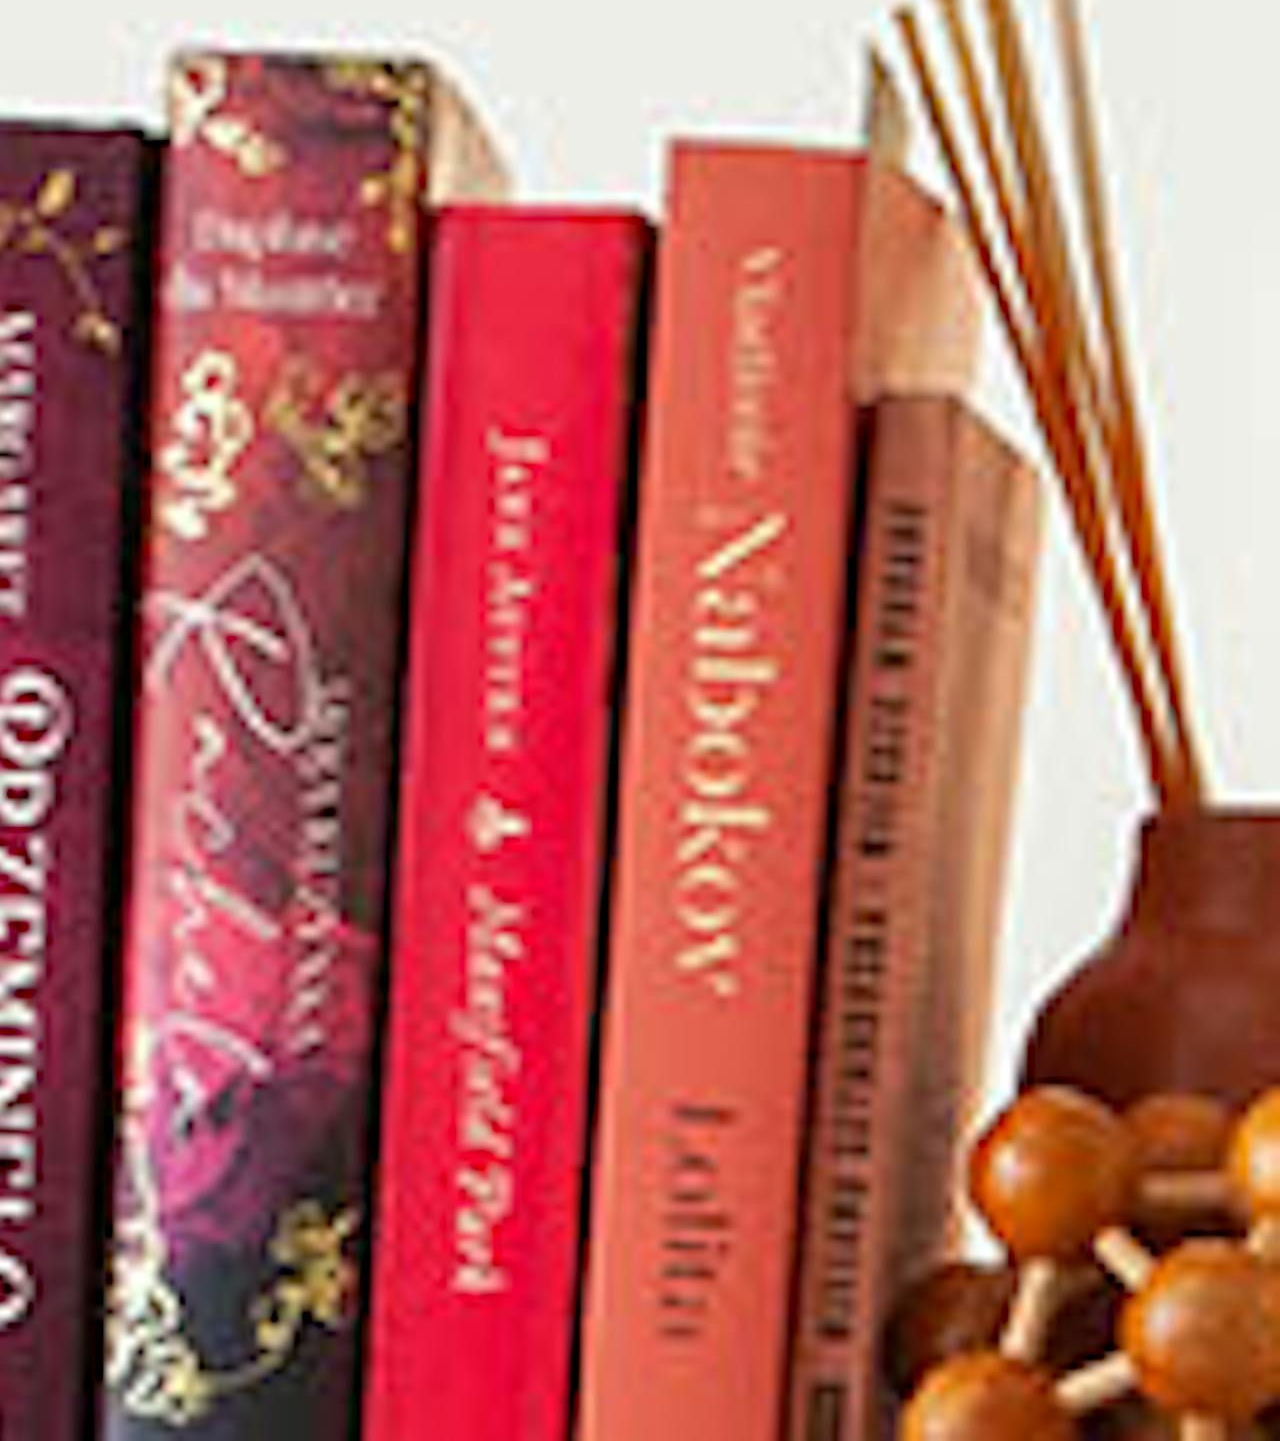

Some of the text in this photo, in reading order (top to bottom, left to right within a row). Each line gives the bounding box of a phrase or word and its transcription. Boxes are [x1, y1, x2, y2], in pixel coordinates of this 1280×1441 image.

[667, 506, 789, 997] Nabokov
[447, 886, 522, 1155] Mansfield
[449, 1164, 510, 1298] Park
[657, 1101, 741, 1345] Lolita
